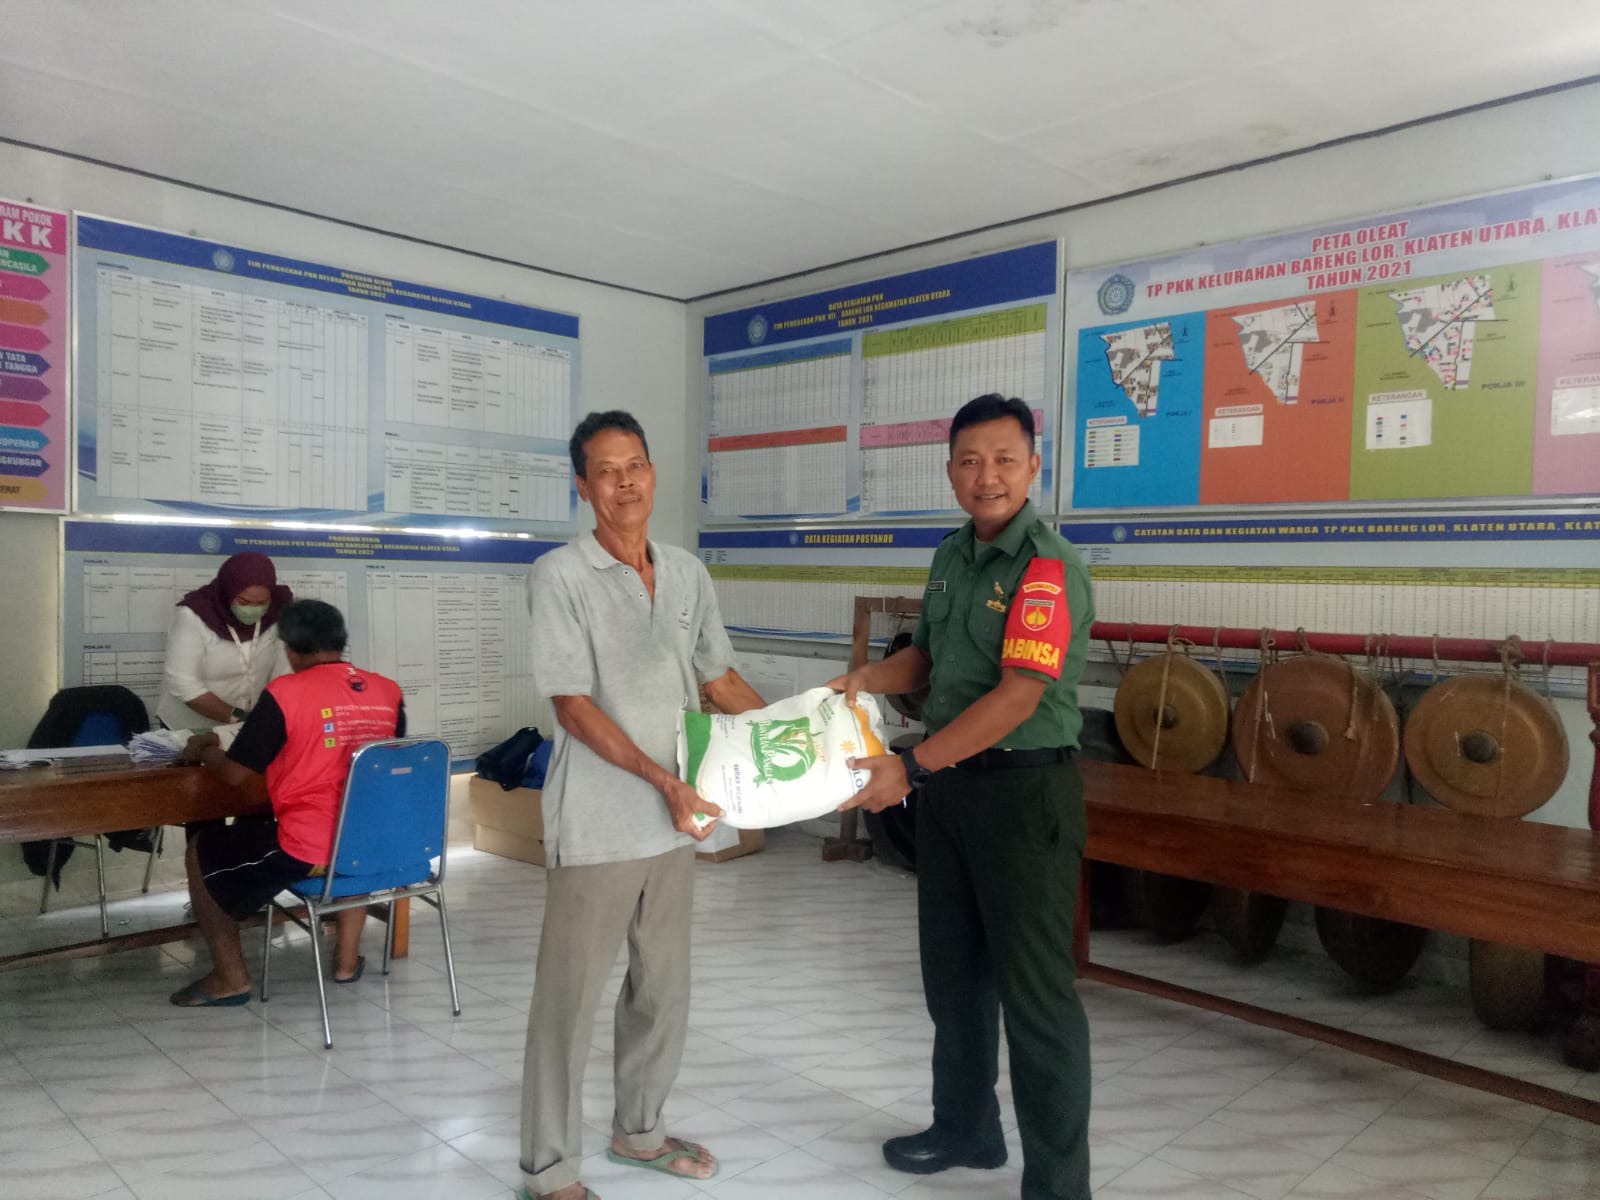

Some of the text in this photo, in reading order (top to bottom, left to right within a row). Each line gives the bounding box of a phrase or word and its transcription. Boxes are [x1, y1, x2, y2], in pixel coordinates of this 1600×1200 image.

[1312, 221, 1409, 253] PETA OLEAT
[1146, 284, 1163, 298] TP
[1166, 277, 1195, 295] PKK
[1198, 262, 1287, 290] KELURAHAN
[1290, 247, 1358, 275] BARENG
[1404, 231, 1474, 256] KLATEN
[1307, 259, 1412, 291] TAHUN 2021
[821, 533, 855, 544] KEGIATAN
[1134, 528, 1174, 536] CATATAN
[1176, 527, 1200, 536] DATA
[1202, 527, 1223, 536] DAN
[1225, 526, 1276, 535] KEGIATAN
[1278, 526, 1319, 535] WARGA
[1323, 525, 1338, 534] TP
[1340, 525, 1365, 534] PKK
[1367, 525, 1418, 533] BARENG
[1453, 523, 1505, 532] KLATEN
